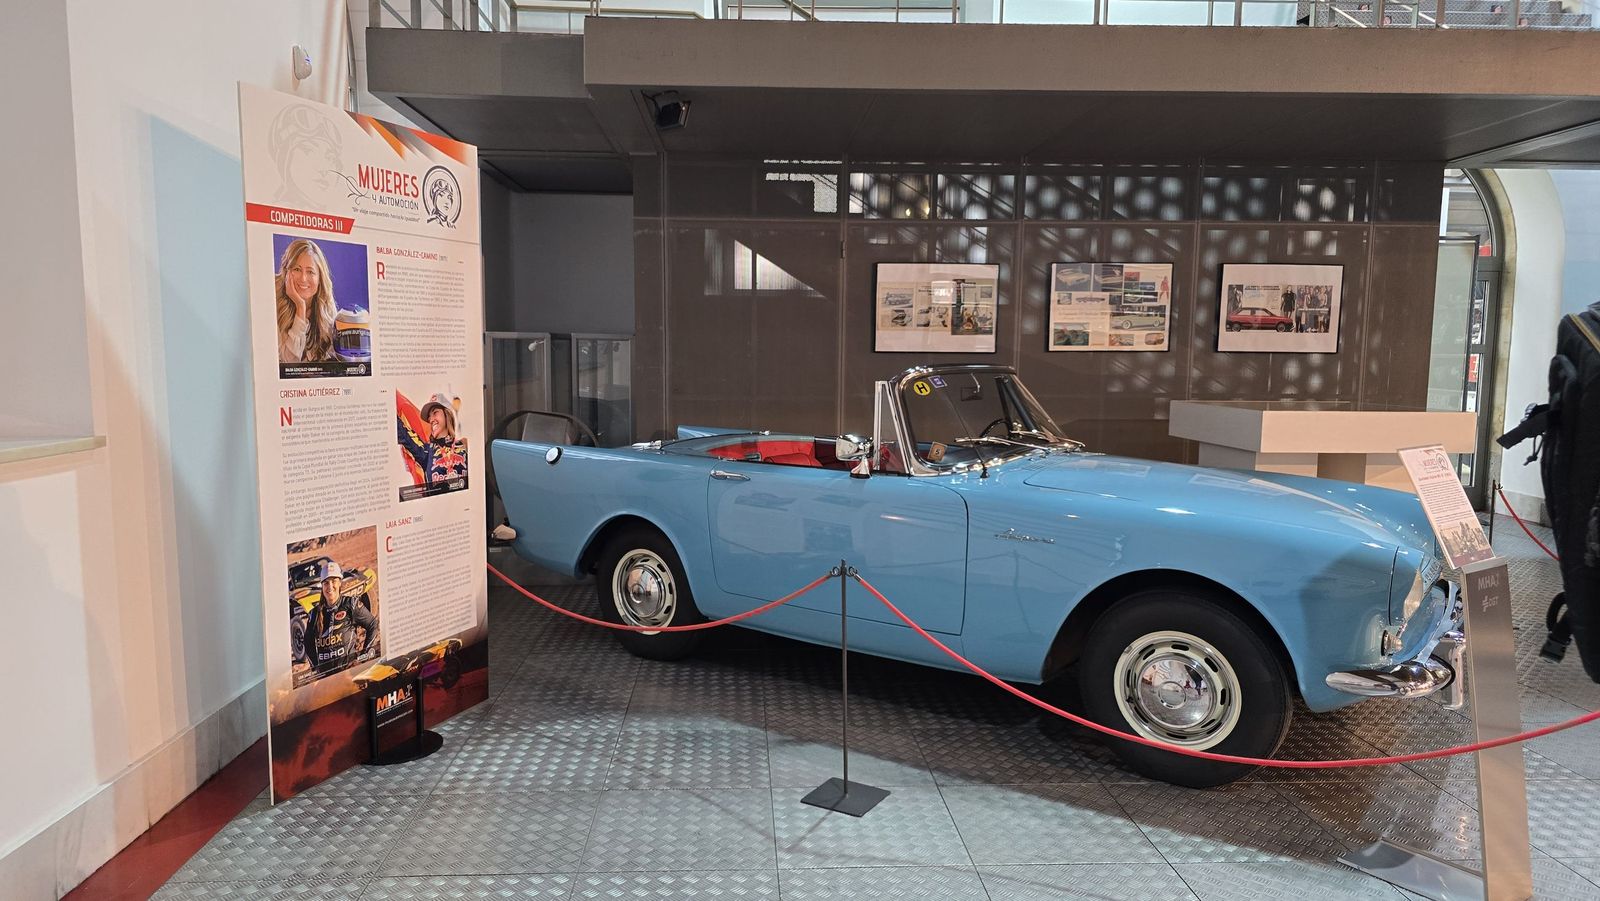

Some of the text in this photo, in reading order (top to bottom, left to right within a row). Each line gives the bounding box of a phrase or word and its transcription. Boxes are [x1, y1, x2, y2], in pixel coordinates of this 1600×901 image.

[358, 163, 420, 199] MUJERES
[378, 195, 419, 211] AUTOMOCIÓN
[270, 210, 343, 232] COMPETIDORAS III
[376, 246, 393, 256] BALBA
[393, 248, 438, 261] GONZÁLEZ-CAMINO
[280, 389, 307, 399] CRISTINA
[308, 386, 340, 397] GUTIÉRREZ
[916, 382, 928, 394] H
[385, 519, 397, 529] LAIA
[398, 516, 412, 526] SANZ
[318, 647, 345, 660] EBRO
